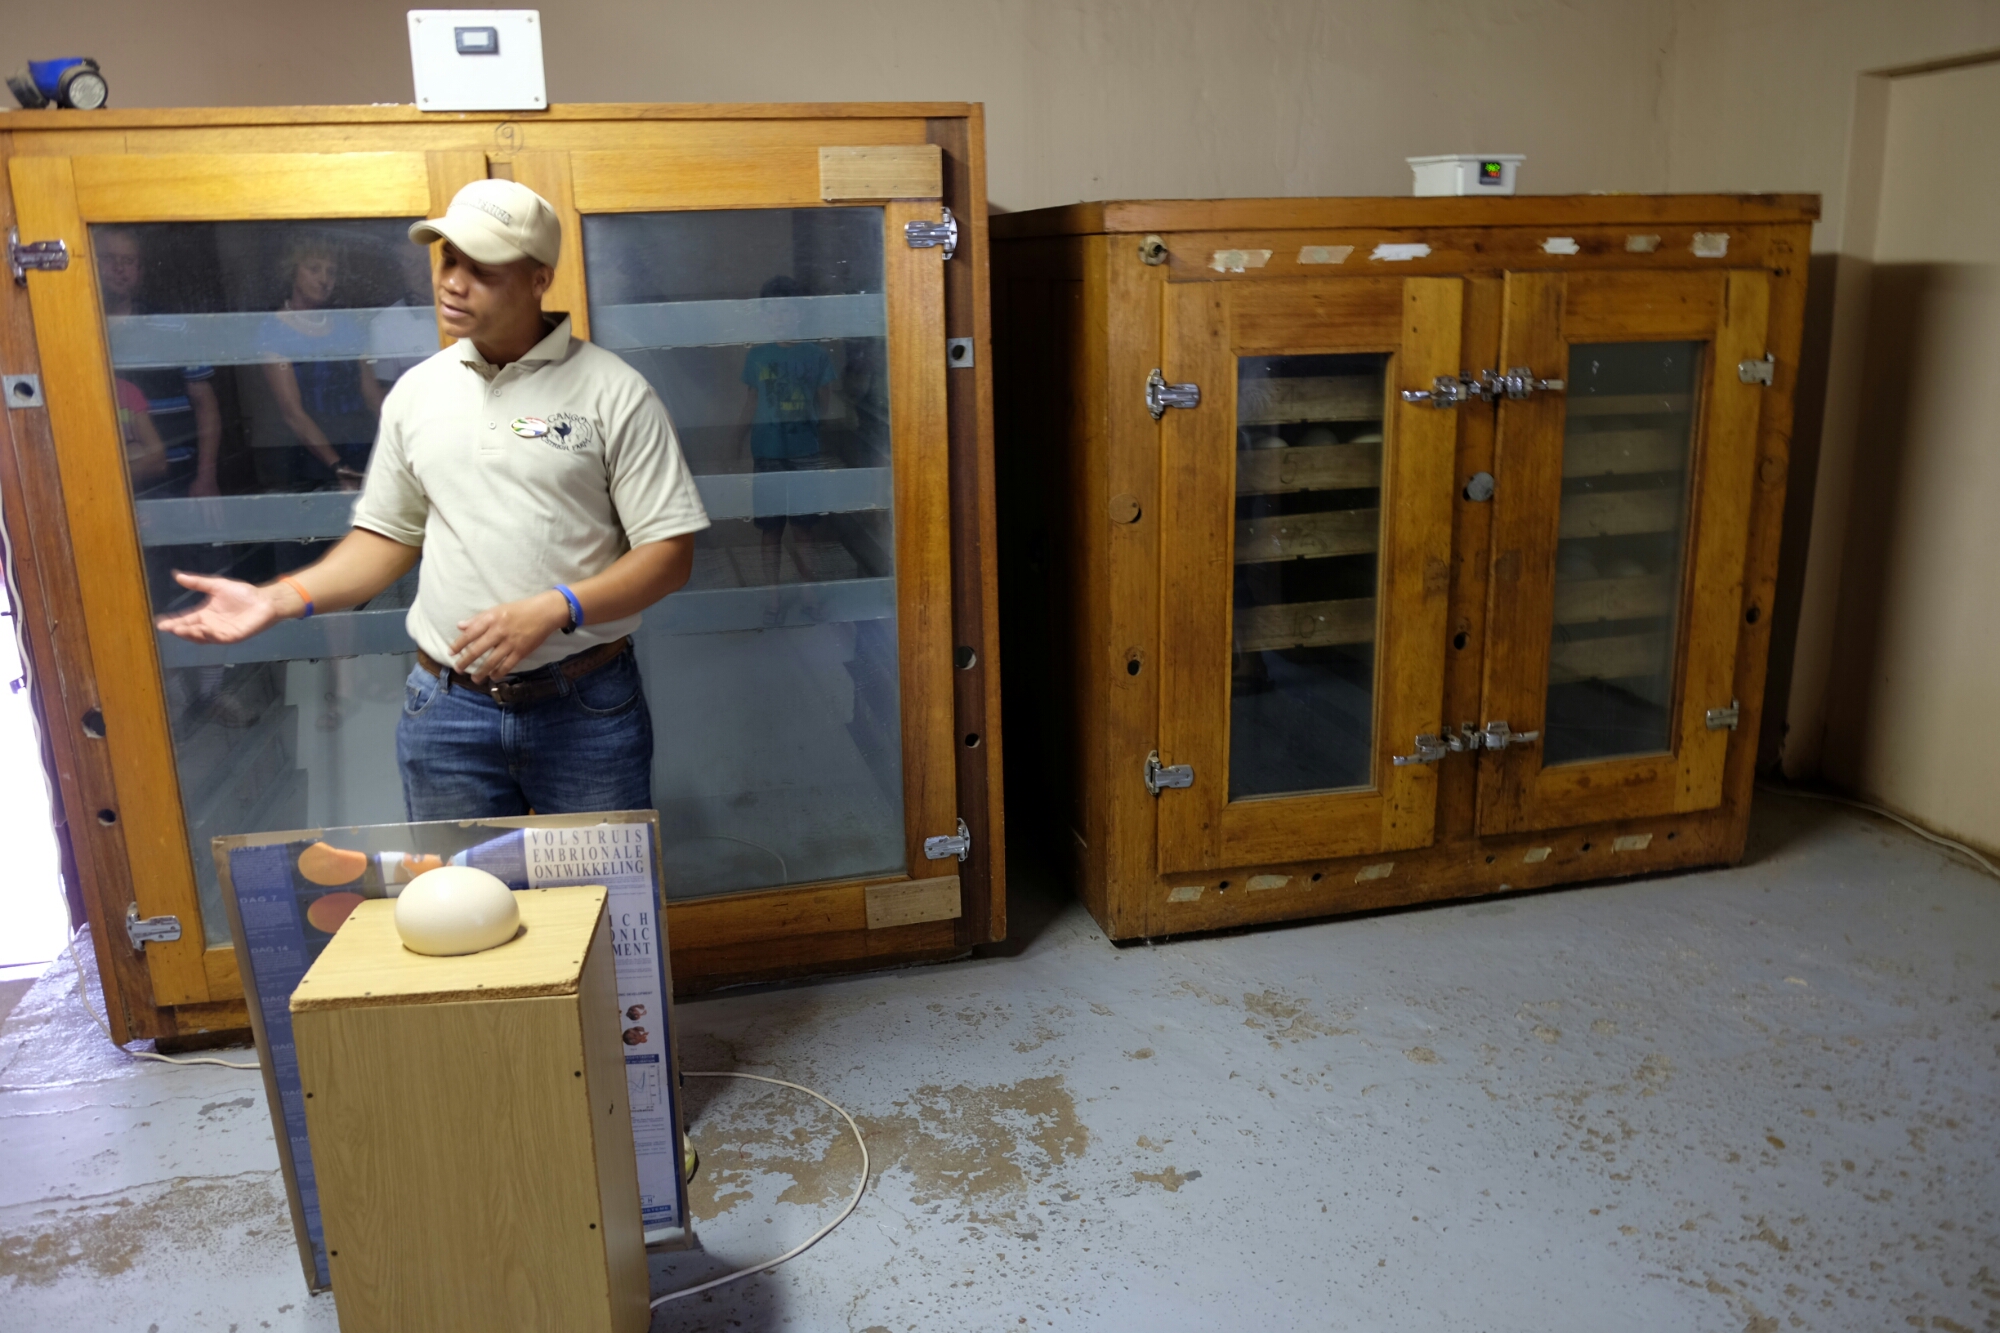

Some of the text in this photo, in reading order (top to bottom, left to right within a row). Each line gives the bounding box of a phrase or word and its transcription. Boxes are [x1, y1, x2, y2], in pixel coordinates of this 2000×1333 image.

[532, 829, 643, 845] VOLSTRUIS
[533, 845, 643, 862] EMBRIONALE
[534, 860, 644, 878] ONTWIKKELING
[240, 895, 267, 905] DAG
[251, 945, 275, 954] DAG
[261, 995, 286, 1003] DAG
[271, 1042, 295, 1051] DAG
